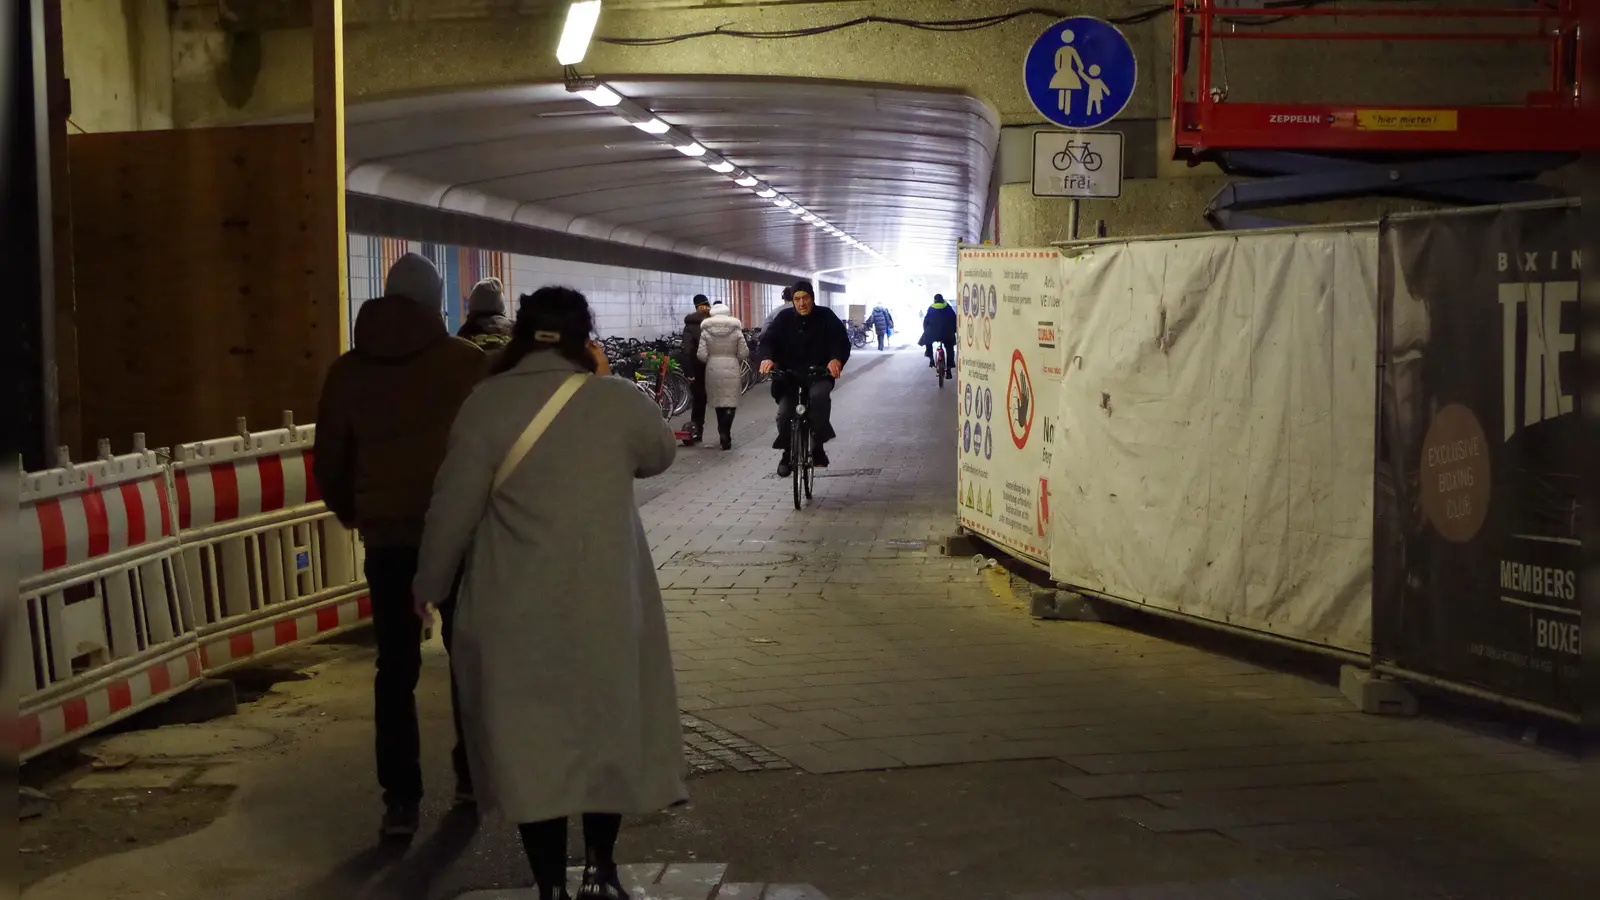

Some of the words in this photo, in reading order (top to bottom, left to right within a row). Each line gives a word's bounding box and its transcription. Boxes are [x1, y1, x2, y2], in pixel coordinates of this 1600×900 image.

[1269, 115, 1321, 124] ZEPPELIN
[1064, 175, 1091, 189] frei
[1428, 437, 1480, 467] EXCLUSIVE
[1438, 466, 1474, 493] BOXING
[1500, 560, 1576, 600] MEMBERS
[1537, 618, 1582, 655] BOXE
